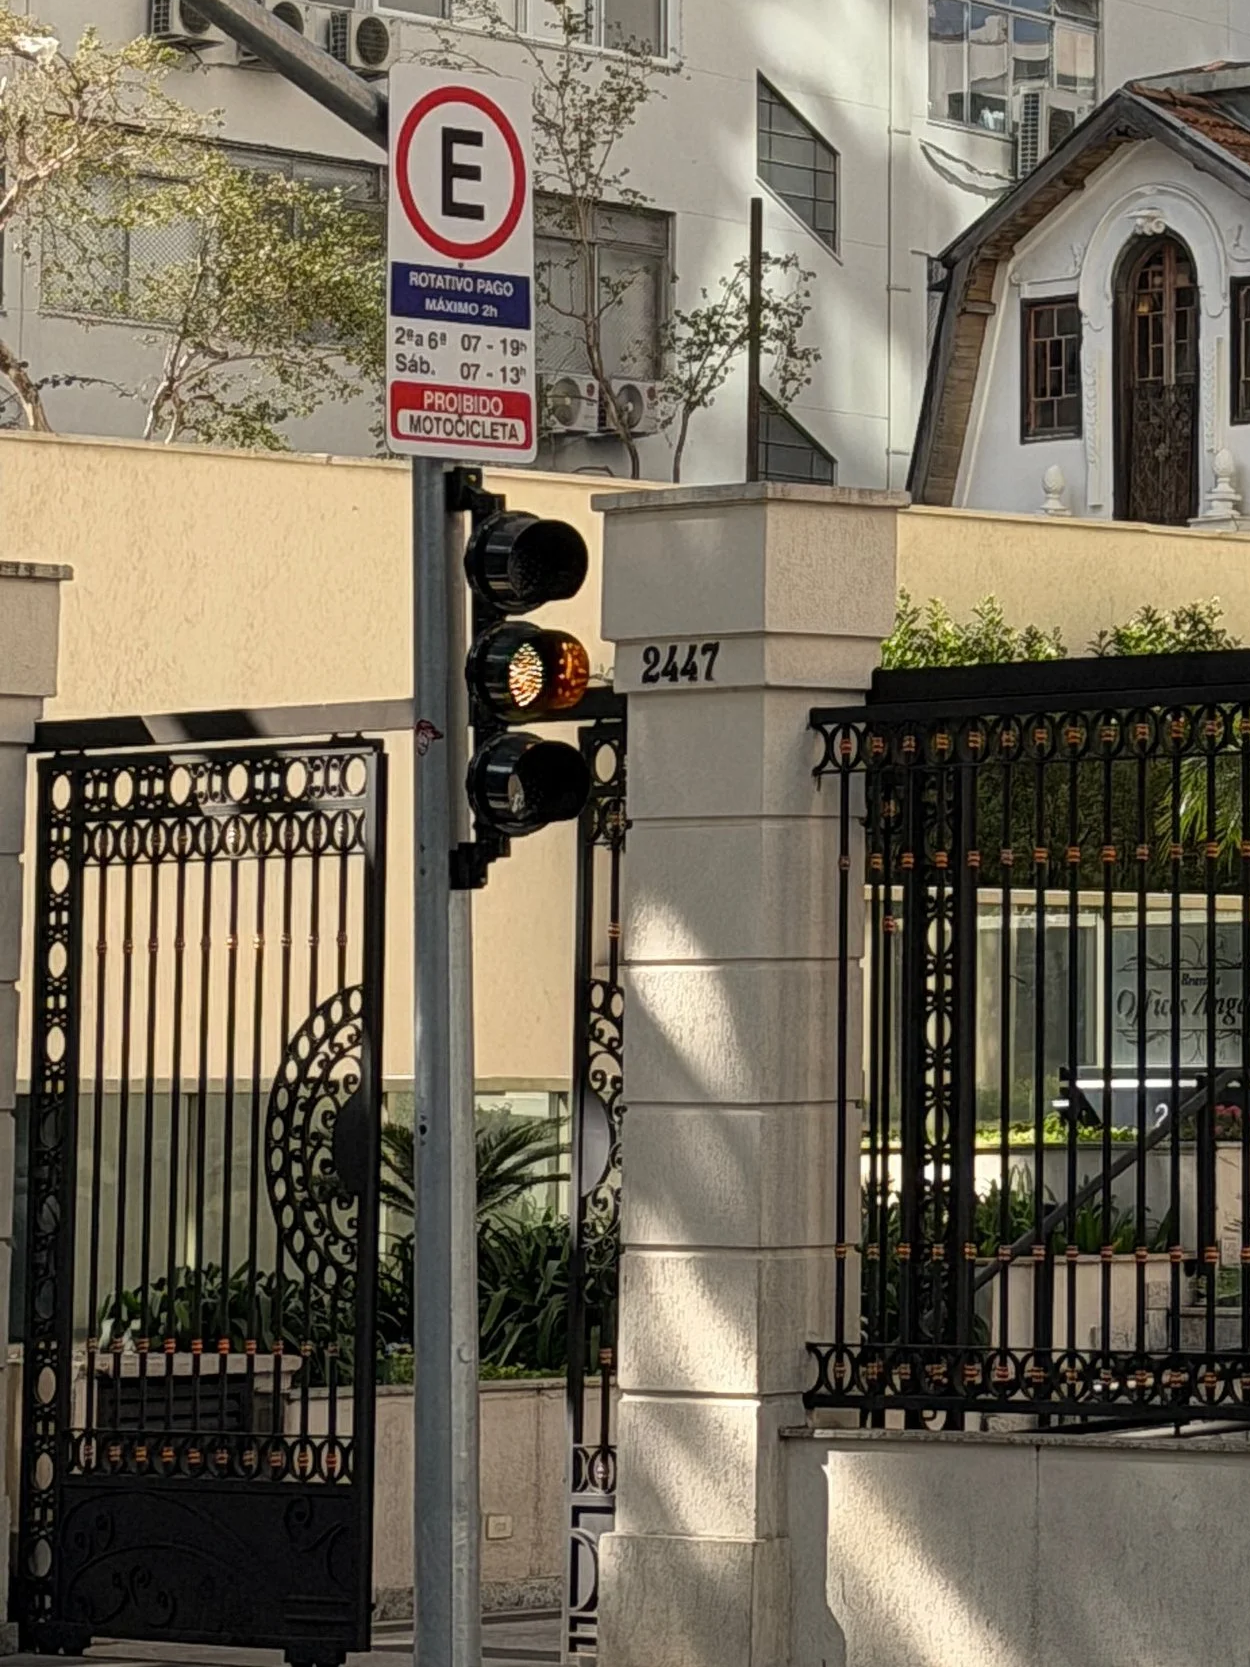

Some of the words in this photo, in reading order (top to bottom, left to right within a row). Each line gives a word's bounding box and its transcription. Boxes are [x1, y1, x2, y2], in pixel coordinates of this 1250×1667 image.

[441, 126, 485, 222] E
[408, 271, 474, 293] ROTATIVO
[476, 278, 514, 297] PAGO
[424, 296, 479, 316] MÁXIMO
[481, 304, 498, 318] 2h
[460, 334, 482, 353] 07
[395, 352, 436, 376] Sáb.
[460, 362, 481, 381] 07
[423, 390, 504, 416] PROIBIDO
[408, 413, 520, 442] MOTOCICLETA
[641, 641, 720, 684] 2447
